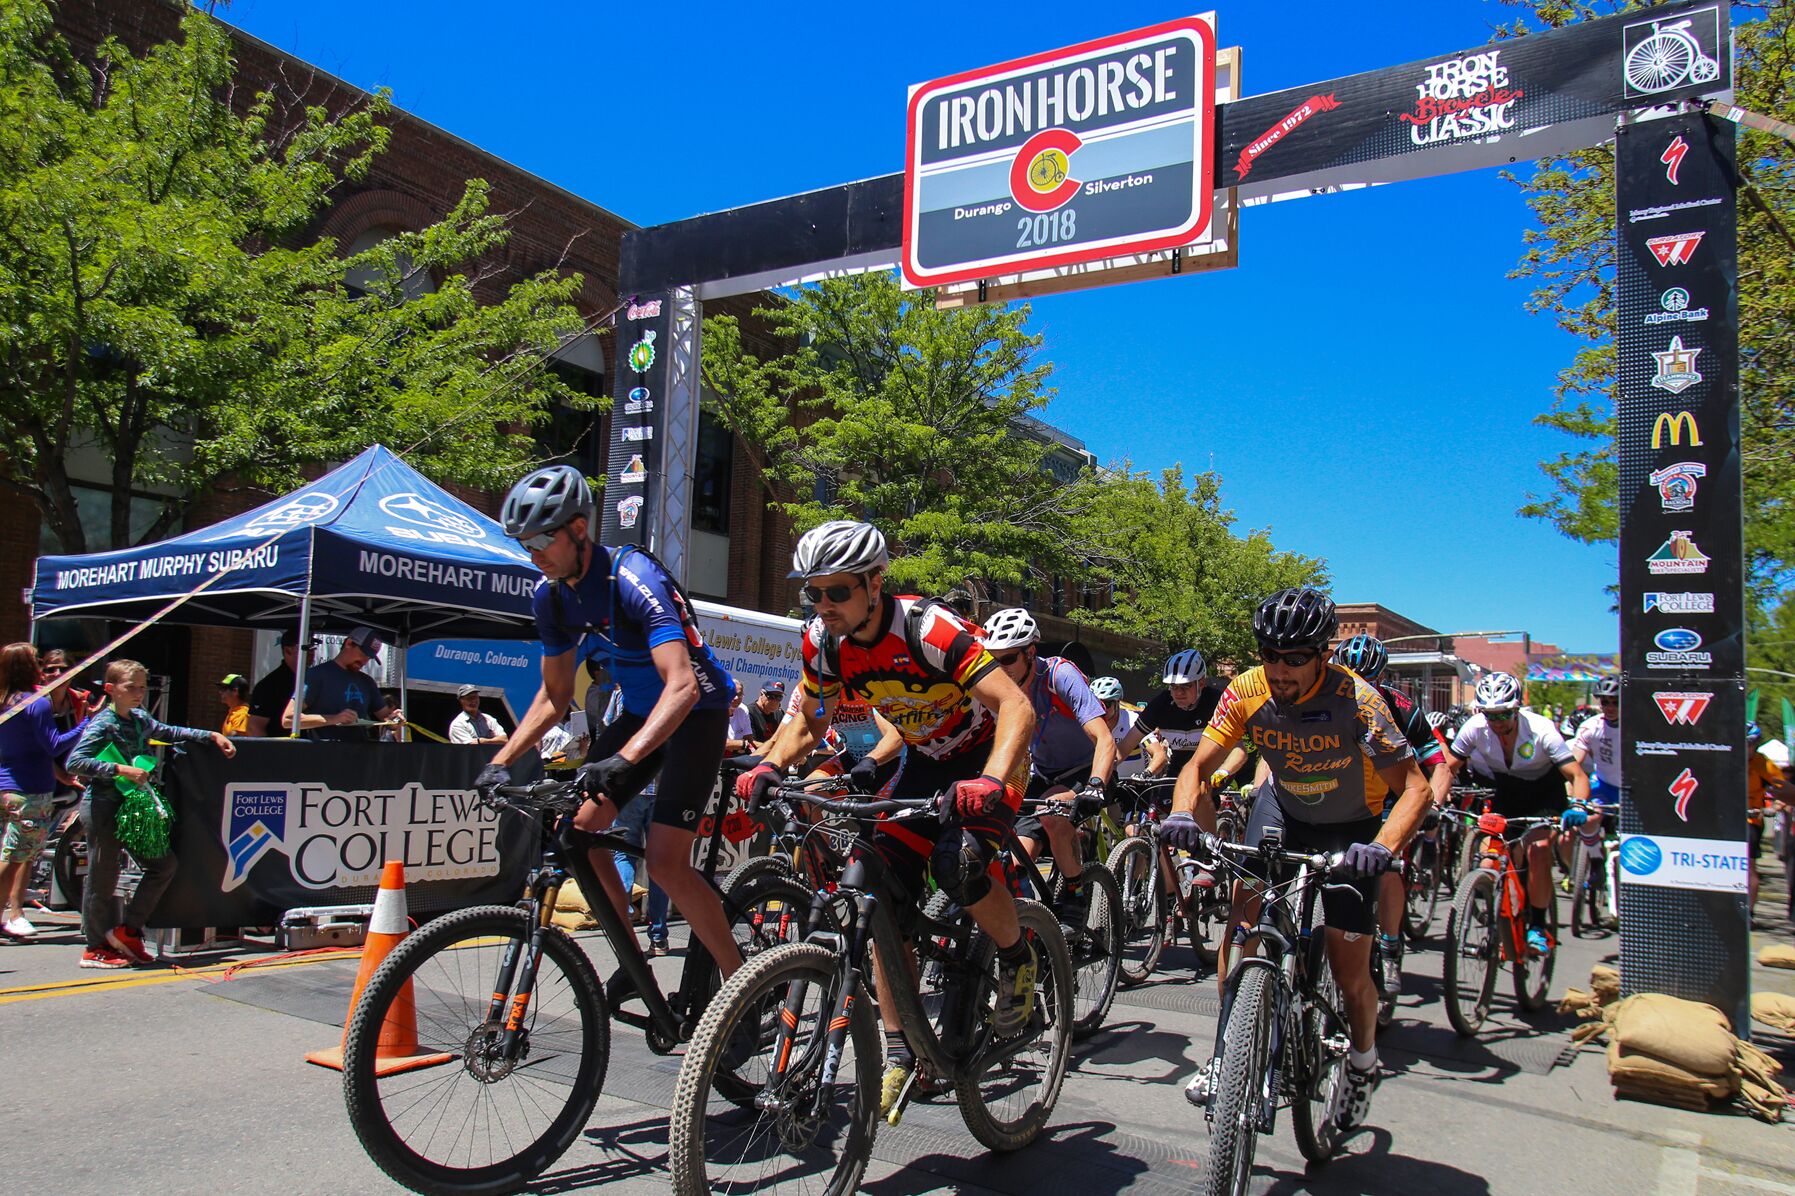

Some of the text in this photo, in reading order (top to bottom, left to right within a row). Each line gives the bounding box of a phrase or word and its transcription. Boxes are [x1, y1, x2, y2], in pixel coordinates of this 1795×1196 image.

[1248, 105, 1312, 157] Since 1972
[1085, 174, 1153, 195] Silverton
[954, 202, 1011, 220] Durango
[1016, 209, 1076, 248] 2018
[1645, 308, 1708, 324] Alpine Bank
[57, 545, 279, 590] MOREHART MURPHY SUBARU
[359, 550, 486, 590] MOREHART
[1650, 560, 1706, 568] MOUNTAIN
[1660, 601, 1713, 611] COLLEGE
[1686, 592, 1713, 601] LEWIS
[709, 629, 741, 652] Lewis
[744, 635, 781, 660] College
[435, 645, 529, 668] Durango, Colorado
[1648, 652, 1709, 662] SUBARU
[736, 658, 800, 680] Championships
[830, 712, 867, 725] ACING
[1253, 725, 1341, 753] ECHELON
[1284, 752, 1353, 773] Racing
[236, 795, 284, 804] FORT LEWIS
[299, 787, 498, 828] FORT LEWIS
[235, 806, 283, 817] COLLEGE
[295, 828, 497, 885] COLLEGE
[1671, 852, 1748, 871] TRI-STATE
[427, 865, 497, 878] COLORADO
